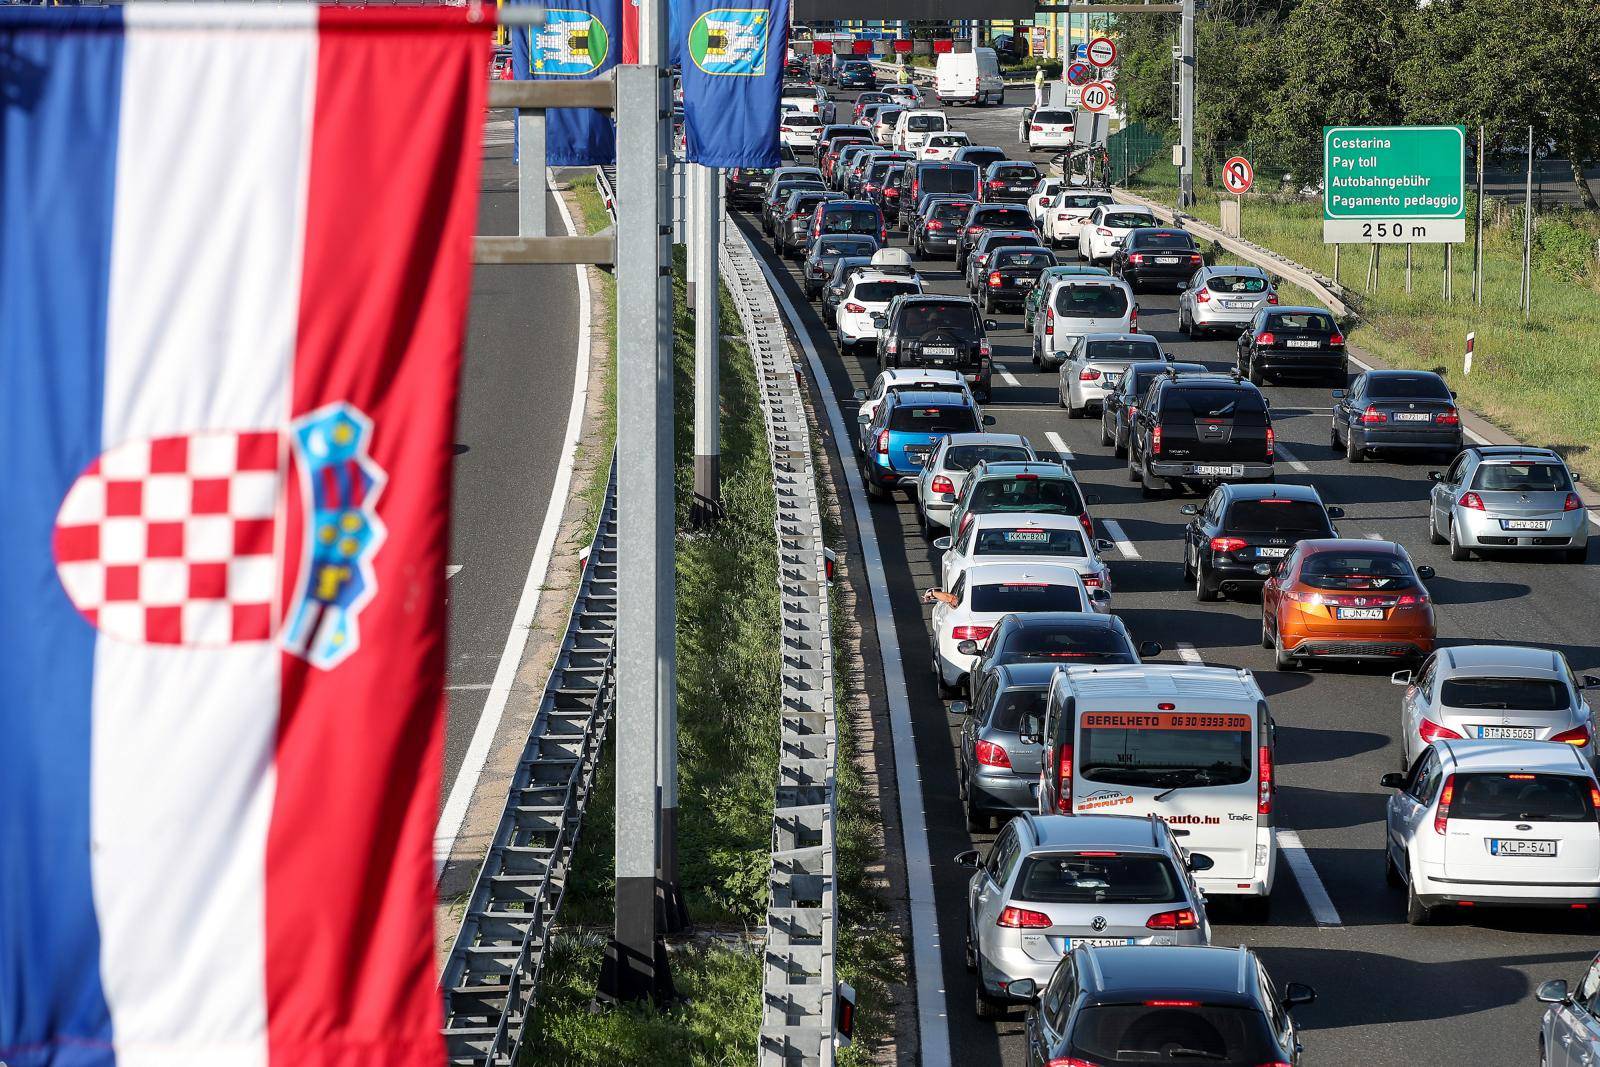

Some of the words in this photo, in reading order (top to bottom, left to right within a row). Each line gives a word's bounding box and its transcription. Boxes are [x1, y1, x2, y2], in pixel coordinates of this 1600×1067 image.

[1087, 90, 1103, 105] 40
[1332, 137, 1391, 149] Cestarina
[1332, 157, 1355, 170] Pay
[1358, 156, 1377, 168] toll
[1332, 175, 1431, 189] Autobahngebühr
[1332, 195, 1400, 209] Pagamento
[1404, 194, 1458, 209] pedaggio
[1362, 223, 1403, 238] 250
[1412, 226, 1426, 237] m
[1343, 608, 1381, 618] LJN-747
[1087, 715, 1160, 727] BERELHETO
[1171, 716, 1184, 727] 06
[1484, 728, 1495, 738] BT
[1147, 813, 1220, 825] -auto.hu
[1227, 813, 1254, 822] Trafic
[1500, 841, 1551, 853] KLP-541
